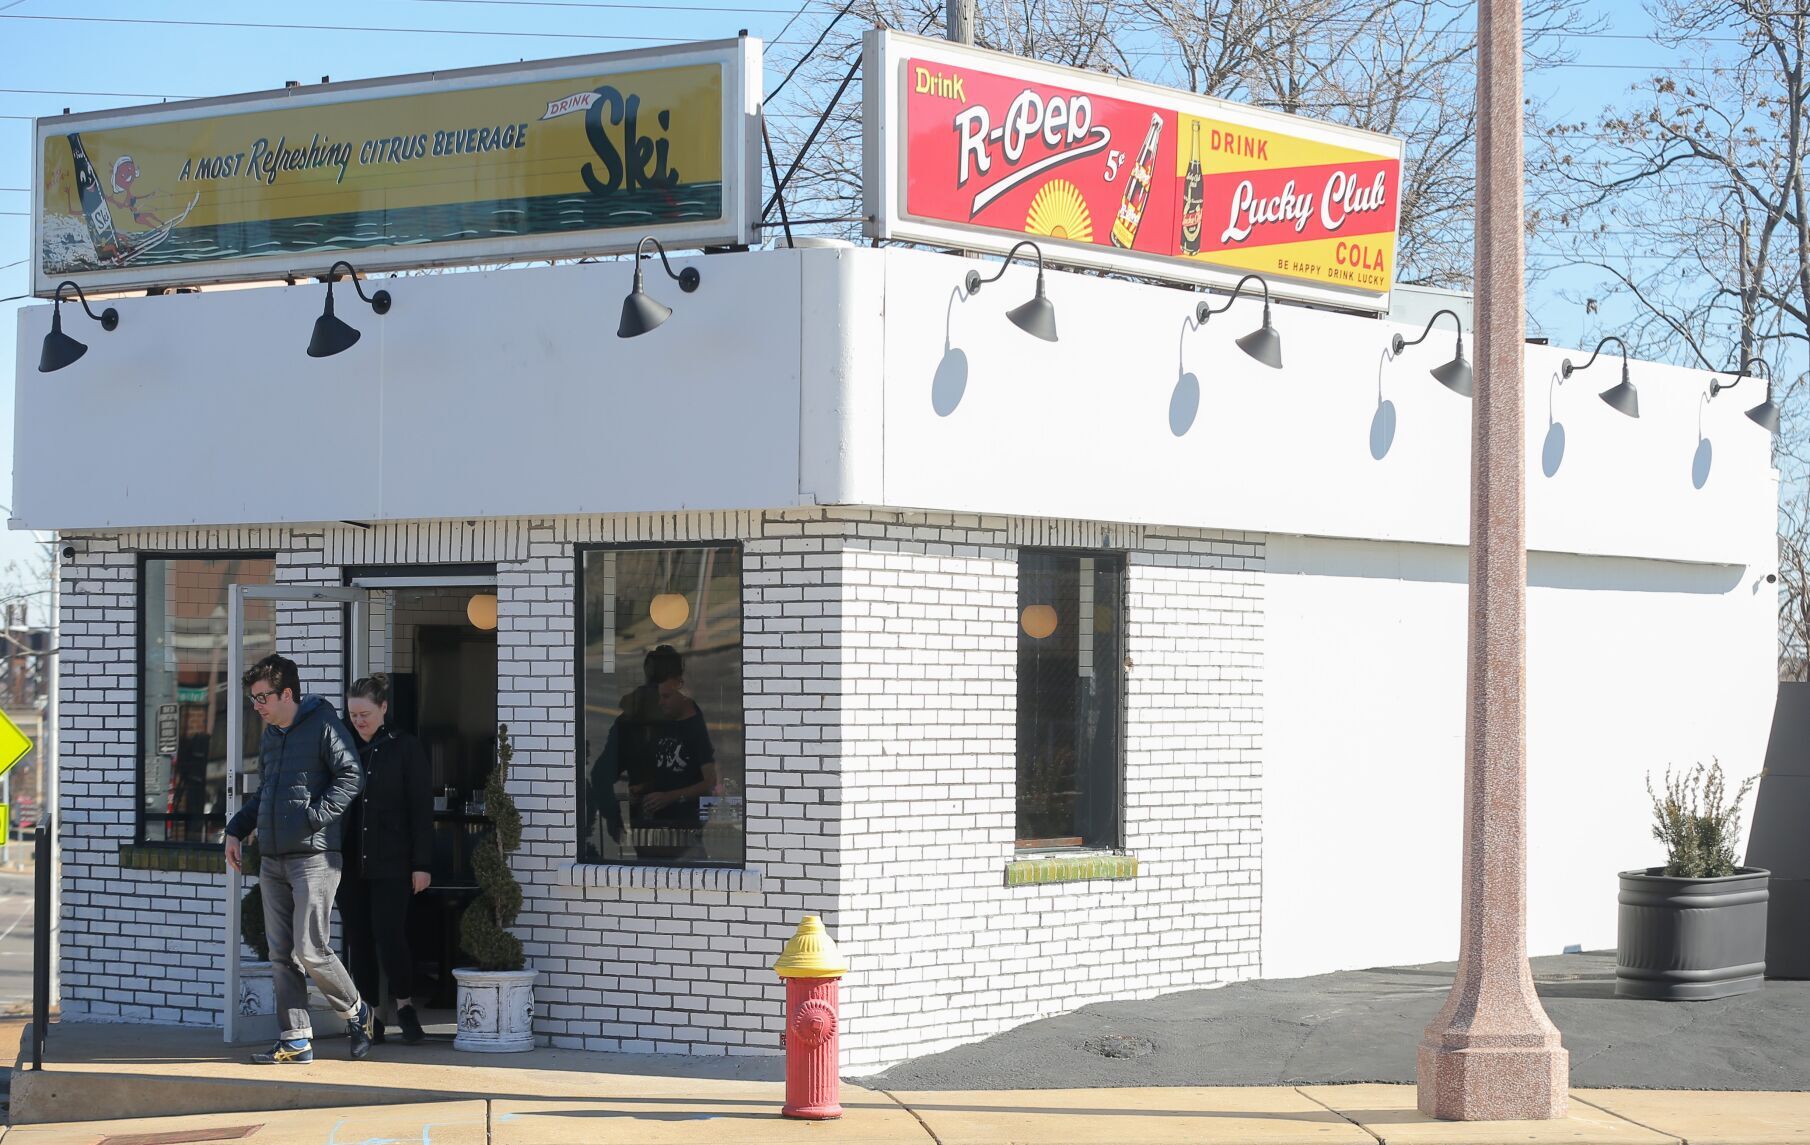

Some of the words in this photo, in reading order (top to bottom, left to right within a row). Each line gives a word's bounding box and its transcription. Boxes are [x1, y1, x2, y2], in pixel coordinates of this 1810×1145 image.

[914, 66, 966, 103] Drink
[549, 94, 591, 115] DRINK
[178, 158, 192, 182] A
[193, 152, 245, 181] MOST
[245, 133, 353, 185] Refreshing
[359, 133, 428, 166] CITRUS
[431, 123, 528, 158] BEVERAGE
[580, 85, 680, 196] Ski
[953, 88, 1094, 190] R-Pep
[1211, 129, 1268, 161] DRINK
[1220, 180, 1314, 243] Lucky
[1320, 170, 1386, 231] Club
[1278, 259, 1289, 270] BE
[1293, 261, 1321, 275] HAPPY
[1328, 267, 1354, 281] DRINK
[1357, 273, 1384, 286] LUCKY
[1335, 241, 1384, 272] COLA
